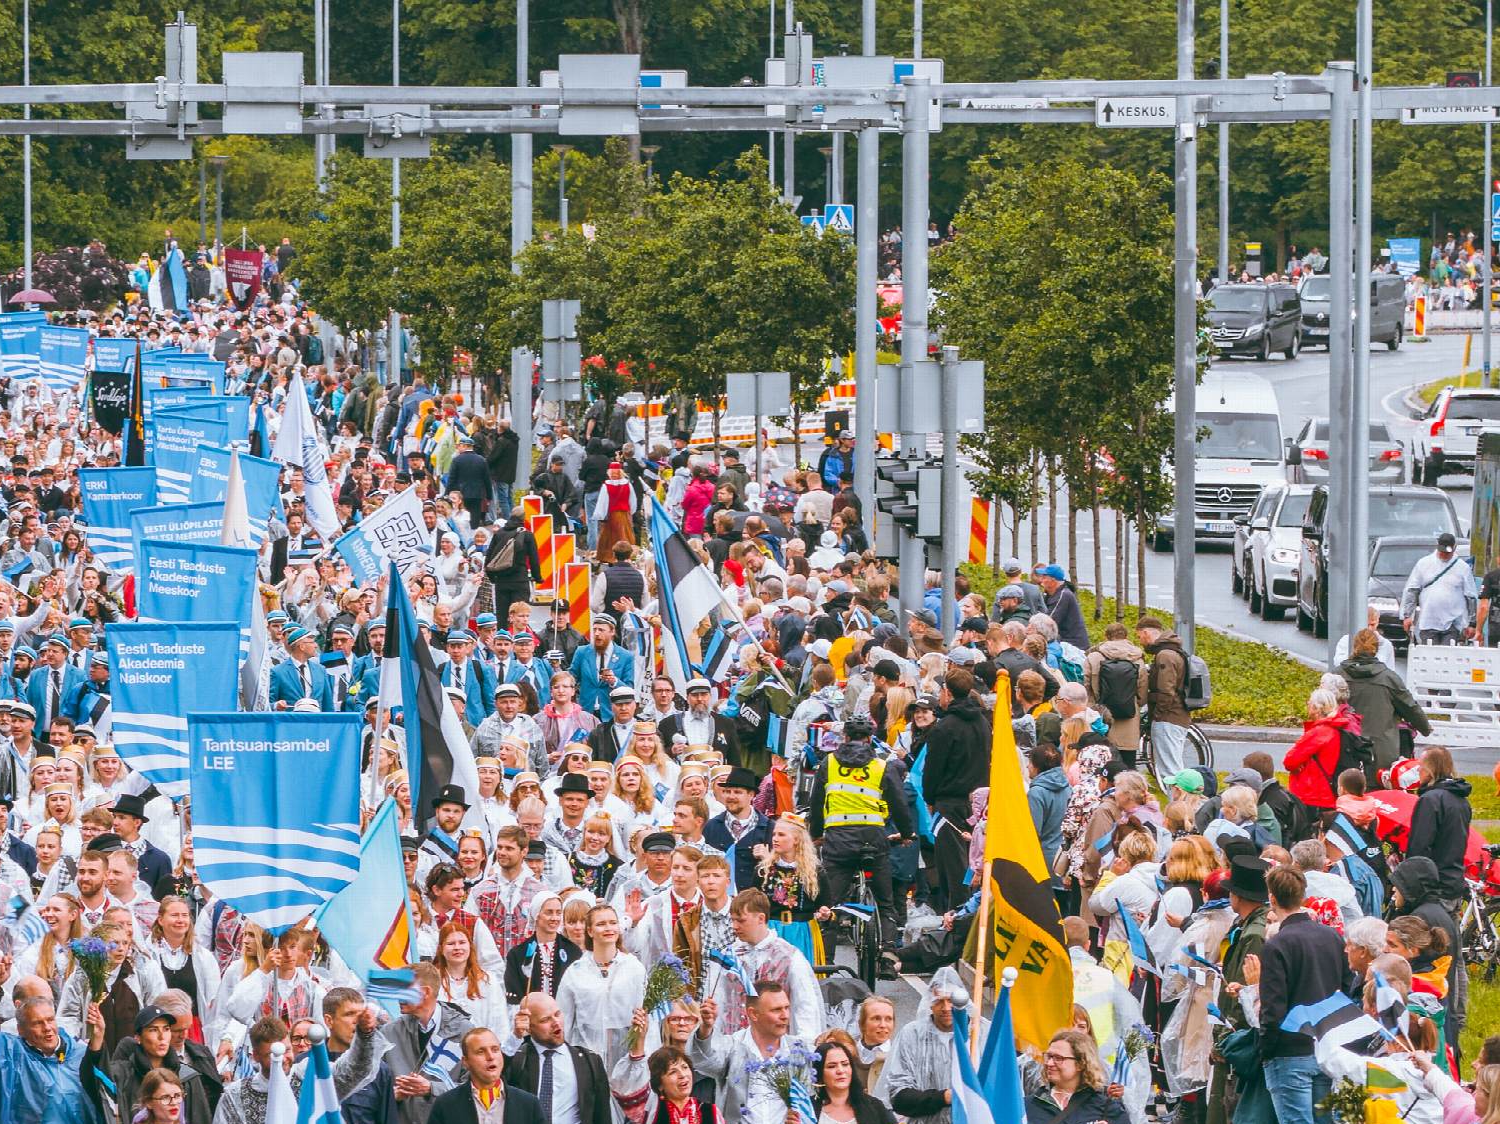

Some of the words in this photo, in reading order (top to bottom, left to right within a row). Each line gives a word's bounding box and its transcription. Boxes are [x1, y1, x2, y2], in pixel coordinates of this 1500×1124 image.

[85, 480, 107, 490] ERKI
[88, 492, 144, 501] Kammerkoor
[144, 523, 167, 534] EESTI
[149, 557, 175, 569] Eesti
[179, 559, 226, 575] Teaduste
[149, 570, 207, 586] Akadeemia
[148, 582, 200, 598] Meeskoor
[117, 643, 147, 655] Eesti
[151, 642, 205, 655] Teaduste
[119, 657, 185, 670] Akadeemia
[119, 672, 172, 684] Naiskoor
[202, 738, 330, 752] Tantsuansambel
[203, 756, 235, 770] LEE
